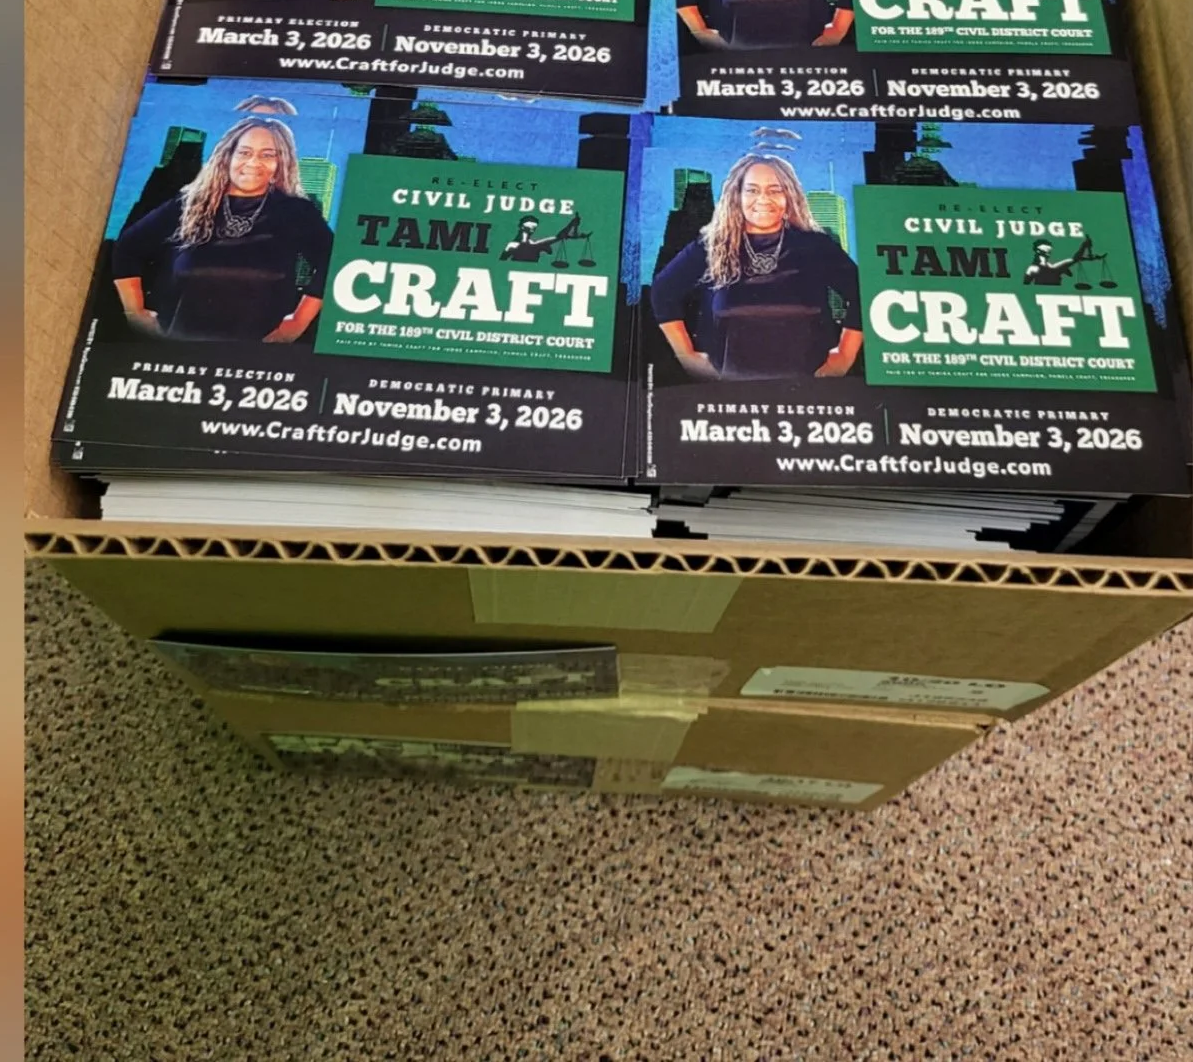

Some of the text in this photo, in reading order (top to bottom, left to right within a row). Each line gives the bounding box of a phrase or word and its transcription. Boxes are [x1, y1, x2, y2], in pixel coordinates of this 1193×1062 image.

[218, 16, 359, 27] PRIMARY ELECTION
[871, 26, 895, 34] FOR
[898, 27, 923, 35] THE
[956, 28, 990, 36] CIVIL
[991, 28, 1049, 36] DISTRICT
[1051, 29, 1093, 37] COURT
[197, 27, 371, 50] March 3, 2026
[424, 25, 586, 40] DEMOCRATIC PRIMARY
[394, 36, 611, 63] November 3, 2026
[279, 57, 524, 78] www.CraftforJudge.com
[911, 68, 1001, 76] DEMOCRATIC
[697, 79, 864, 99] March 3, 2026
[887, 80, 1099, 101] November 3, 2026
[780, 104, 1020, 120] www.CraftforJudge.com
[432, 177, 537, 190] RE-ELECT
[393, 189, 573, 214] CIVIL JUDGE
[939, 204, 1042, 214] RE-ELECT
[357, 214, 491, 254] TAMI
[905, 218, 1083, 238] CIVIL JUDGE
[877, 245, 1011, 278] TAMI
[332, 260, 607, 327] CRAFT
[870, 290, 1135, 348] CRAFT
[336, 322, 364, 333] FOR
[368, 324, 397, 336] THE
[436, 329, 473, 340] CIVIL
[476, 332, 543, 345] DISTRICT
[546, 336, 594, 348] COURT
[883, 353, 910, 363] FOR
[913, 353, 941, 364] THE
[980, 355, 1017, 366] CIVIL
[1020, 356, 1085, 368] DISTRICT
[1087, 358, 1134, 368] COURT
[133, 362, 295, 382] PRIMARY ELECTION
[108, 377, 308, 411] March 3, 2026
[369, 379, 554, 400] DEMOCRATIC PRIMARY
[333, 393, 582, 430] November 3, 2026
[698, 404, 854, 415] PRIMARY ELECTION
[928, 408, 1109, 420] DEMOCRATIC PRIMARY
[202, 421, 481, 453] www.CraftforJudge.com
[681, 419, 873, 448] March 3, 2026
[899, 424, 1142, 452] November 3, 2026
[777, 454, 1051, 478] www.CraftforJudge.com
